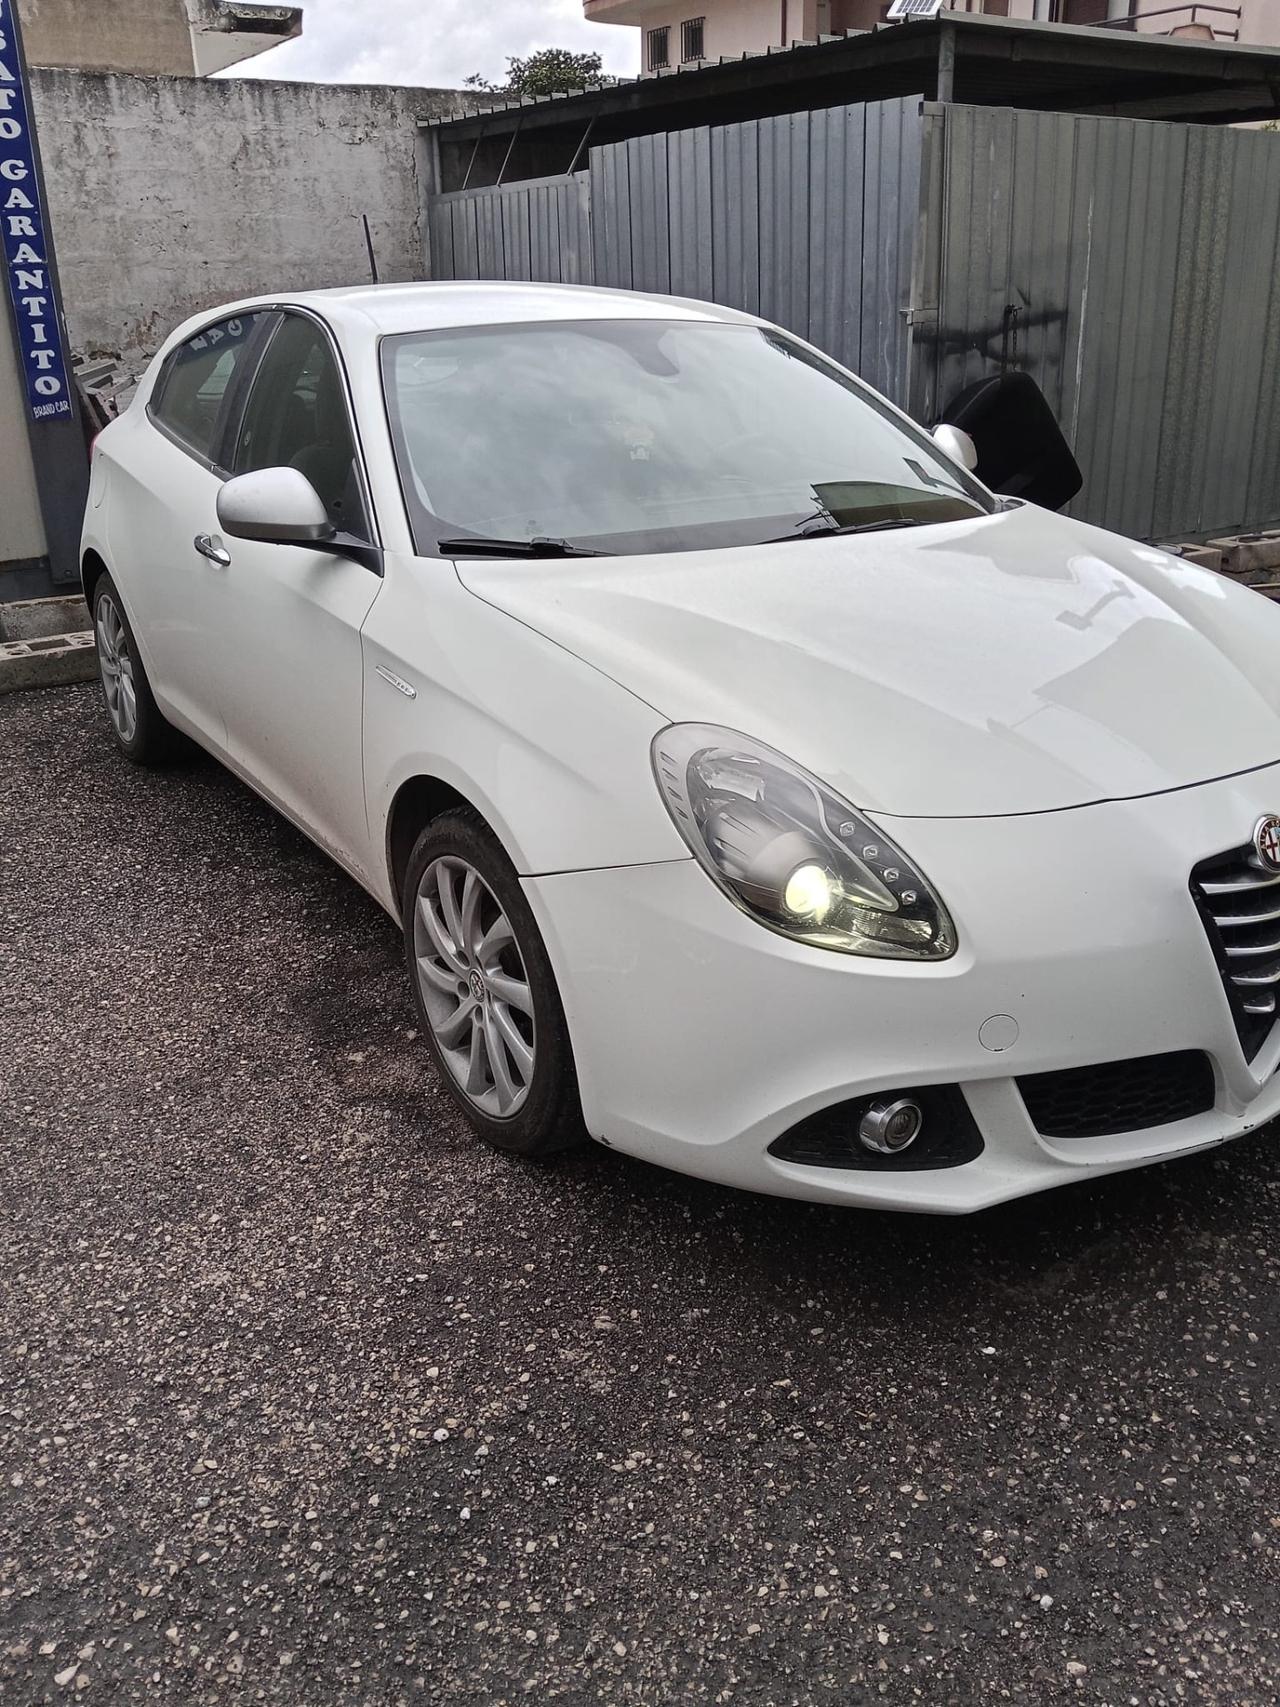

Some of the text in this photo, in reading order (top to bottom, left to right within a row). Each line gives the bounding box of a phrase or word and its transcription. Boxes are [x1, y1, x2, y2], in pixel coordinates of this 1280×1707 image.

[0, 0, 61, 396] ATO GARANTITO
[33, 400, 70, 418] BRAND CAR
